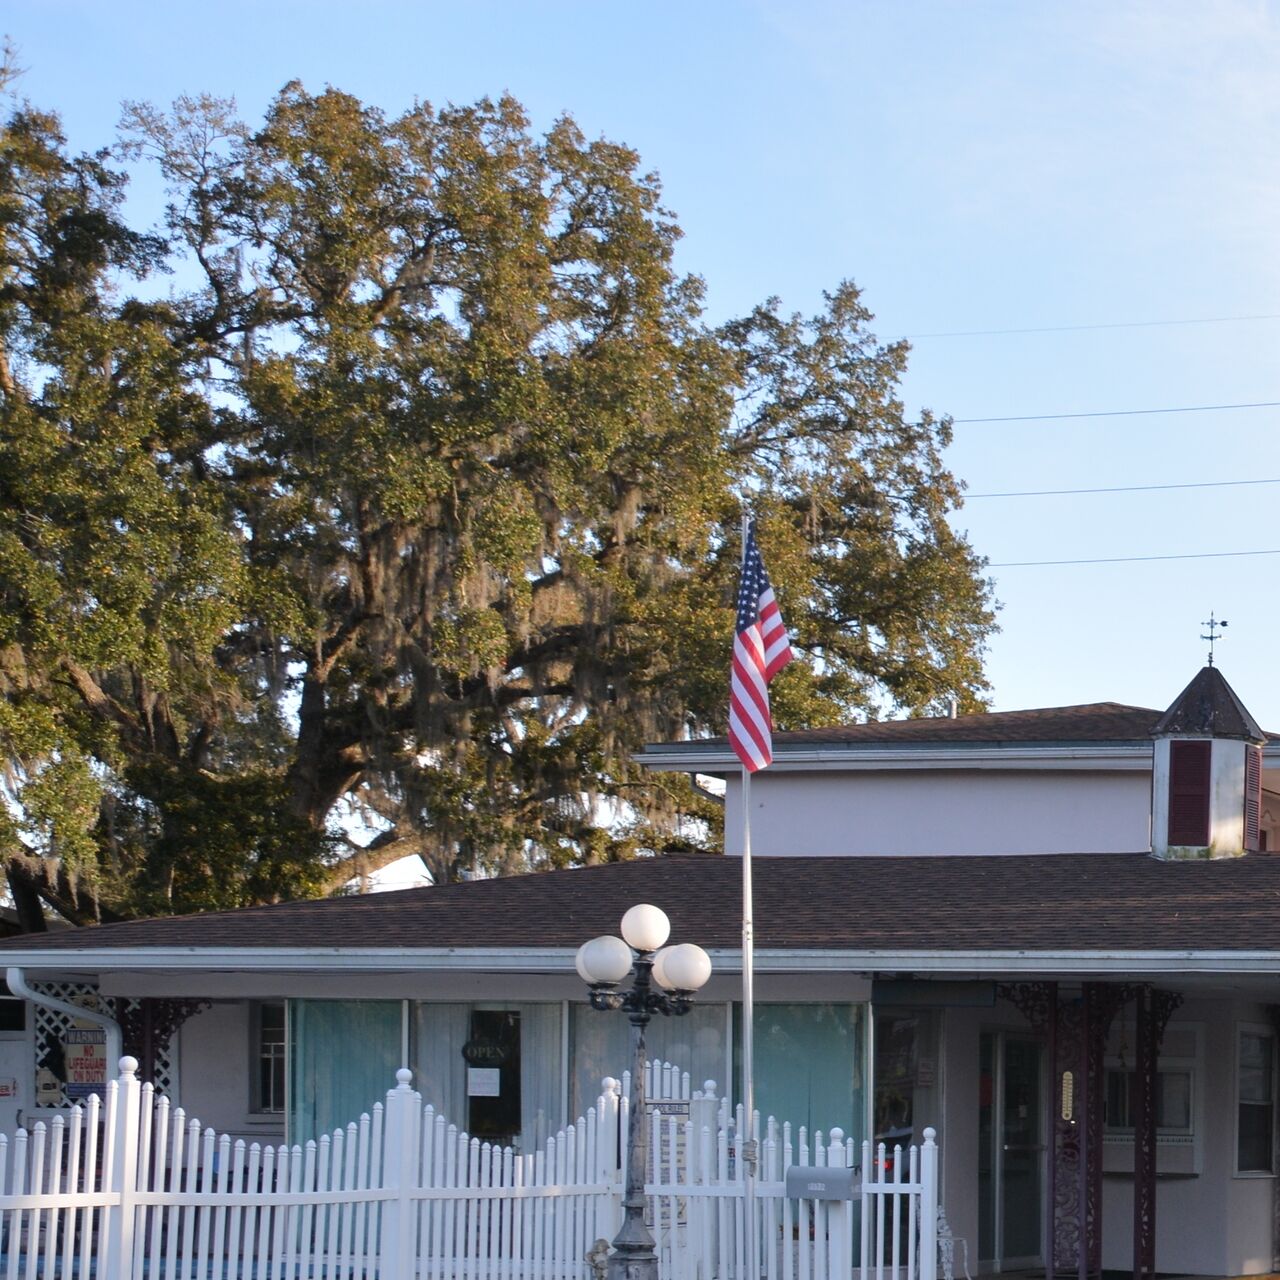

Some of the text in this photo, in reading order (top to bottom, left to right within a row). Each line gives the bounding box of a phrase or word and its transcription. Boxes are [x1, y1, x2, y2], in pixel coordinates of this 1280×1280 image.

[83, 1045, 95, 1057] NO
[466, 1047, 504, 1058] OPEN
[69, 1058, 107, 1070] LIFEGUAR
[74, 1070, 105, 1083] ON DUTY
